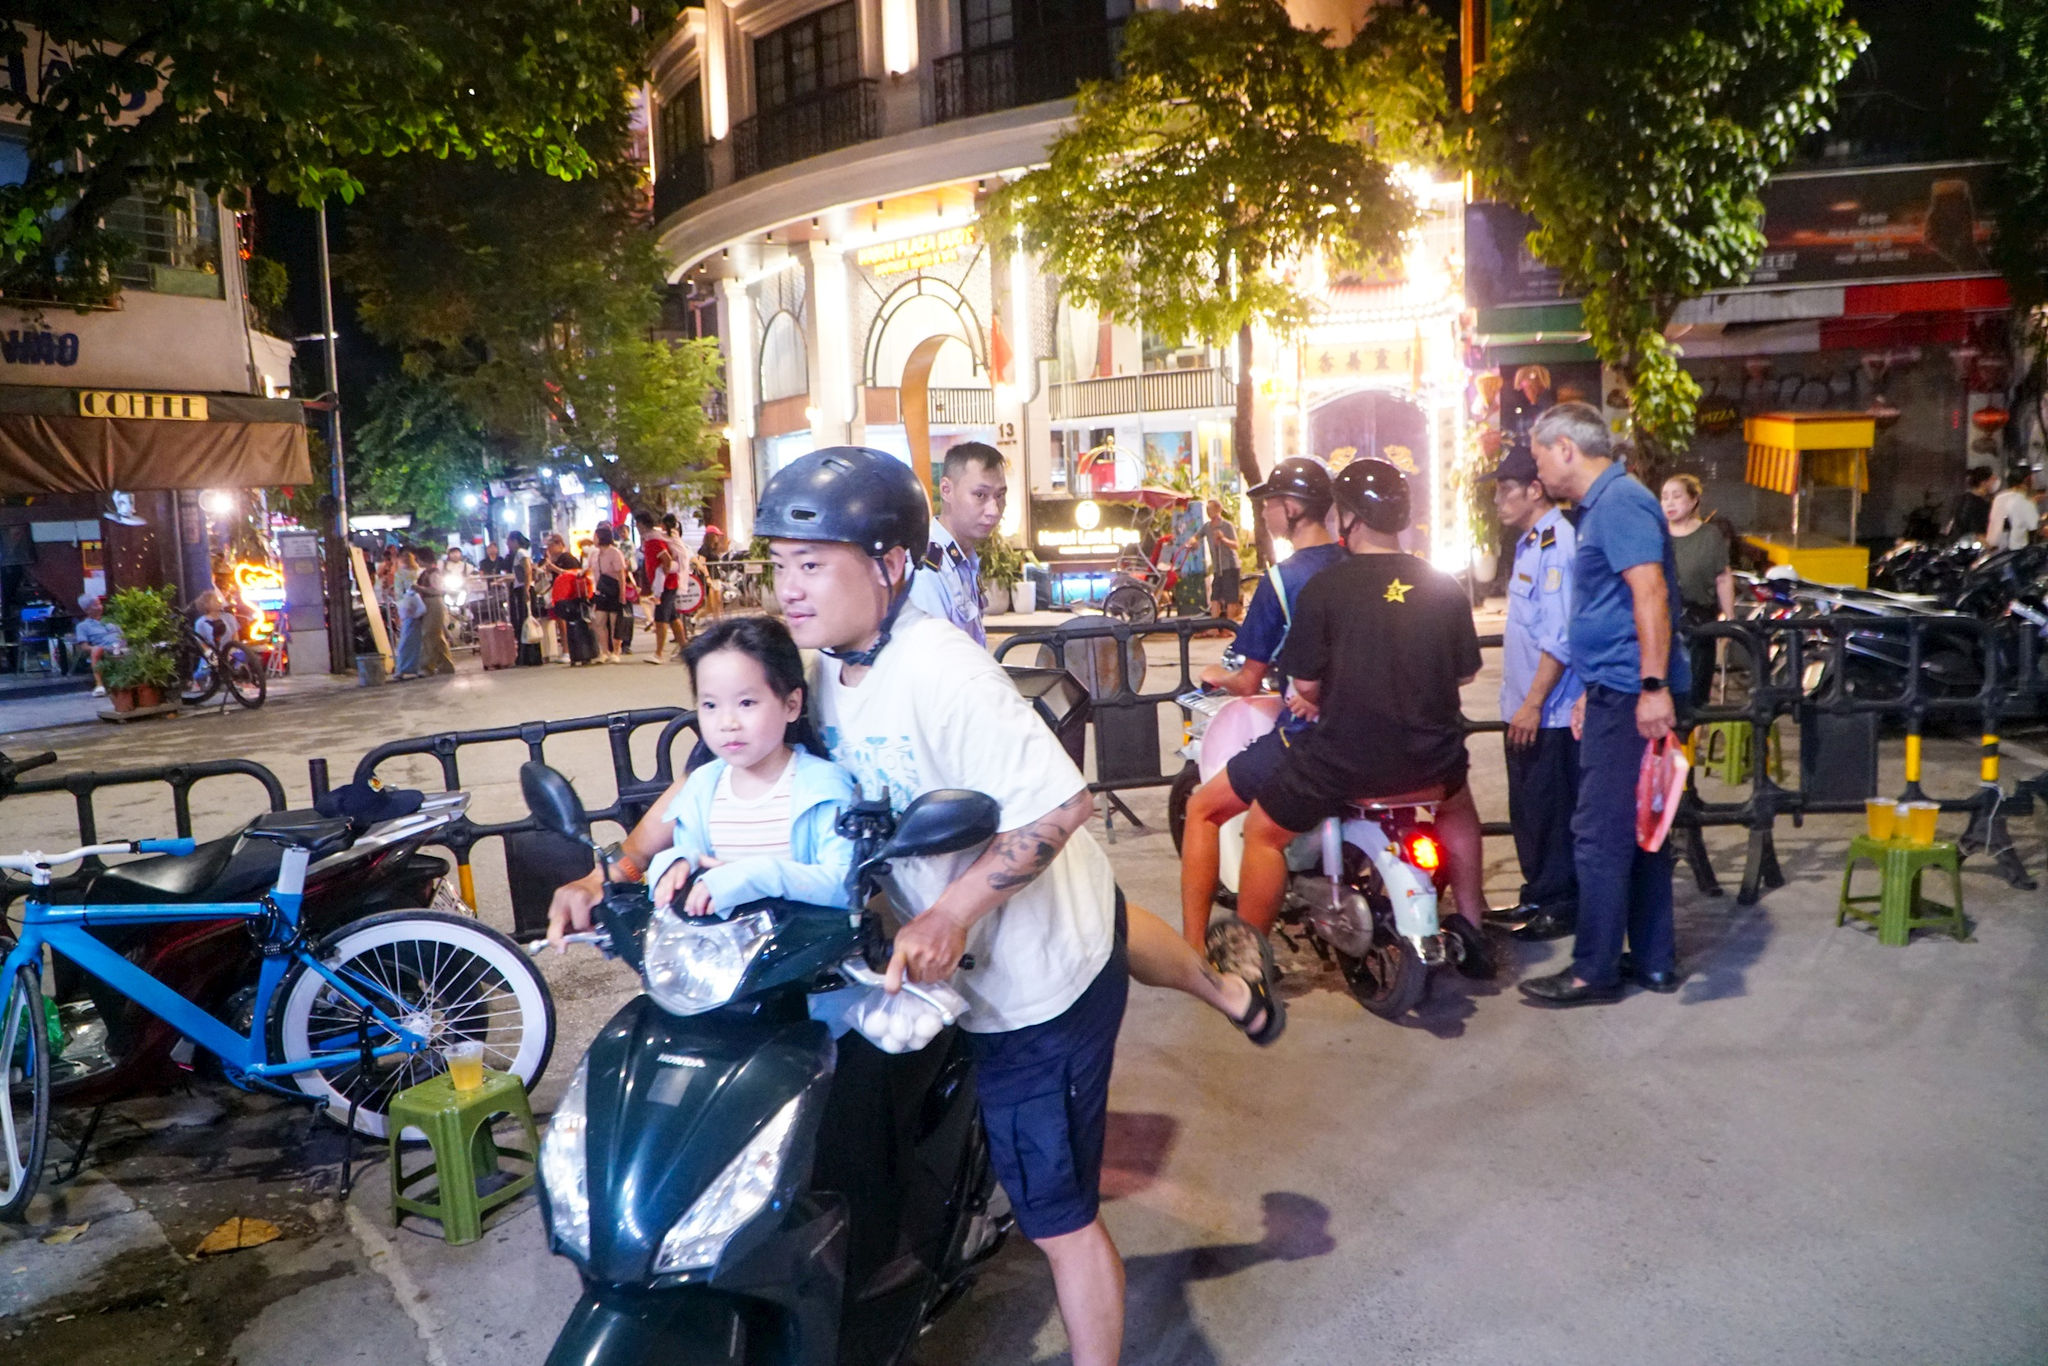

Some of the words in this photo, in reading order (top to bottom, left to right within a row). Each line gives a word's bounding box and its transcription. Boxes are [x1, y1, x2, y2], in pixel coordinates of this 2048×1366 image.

[84, 392, 201, 418] COFFEE
[1701, 408, 1736, 424] PIZZA
[998, 422, 1015, 438] 13
[656, 1053, 706, 1068] HONDA
